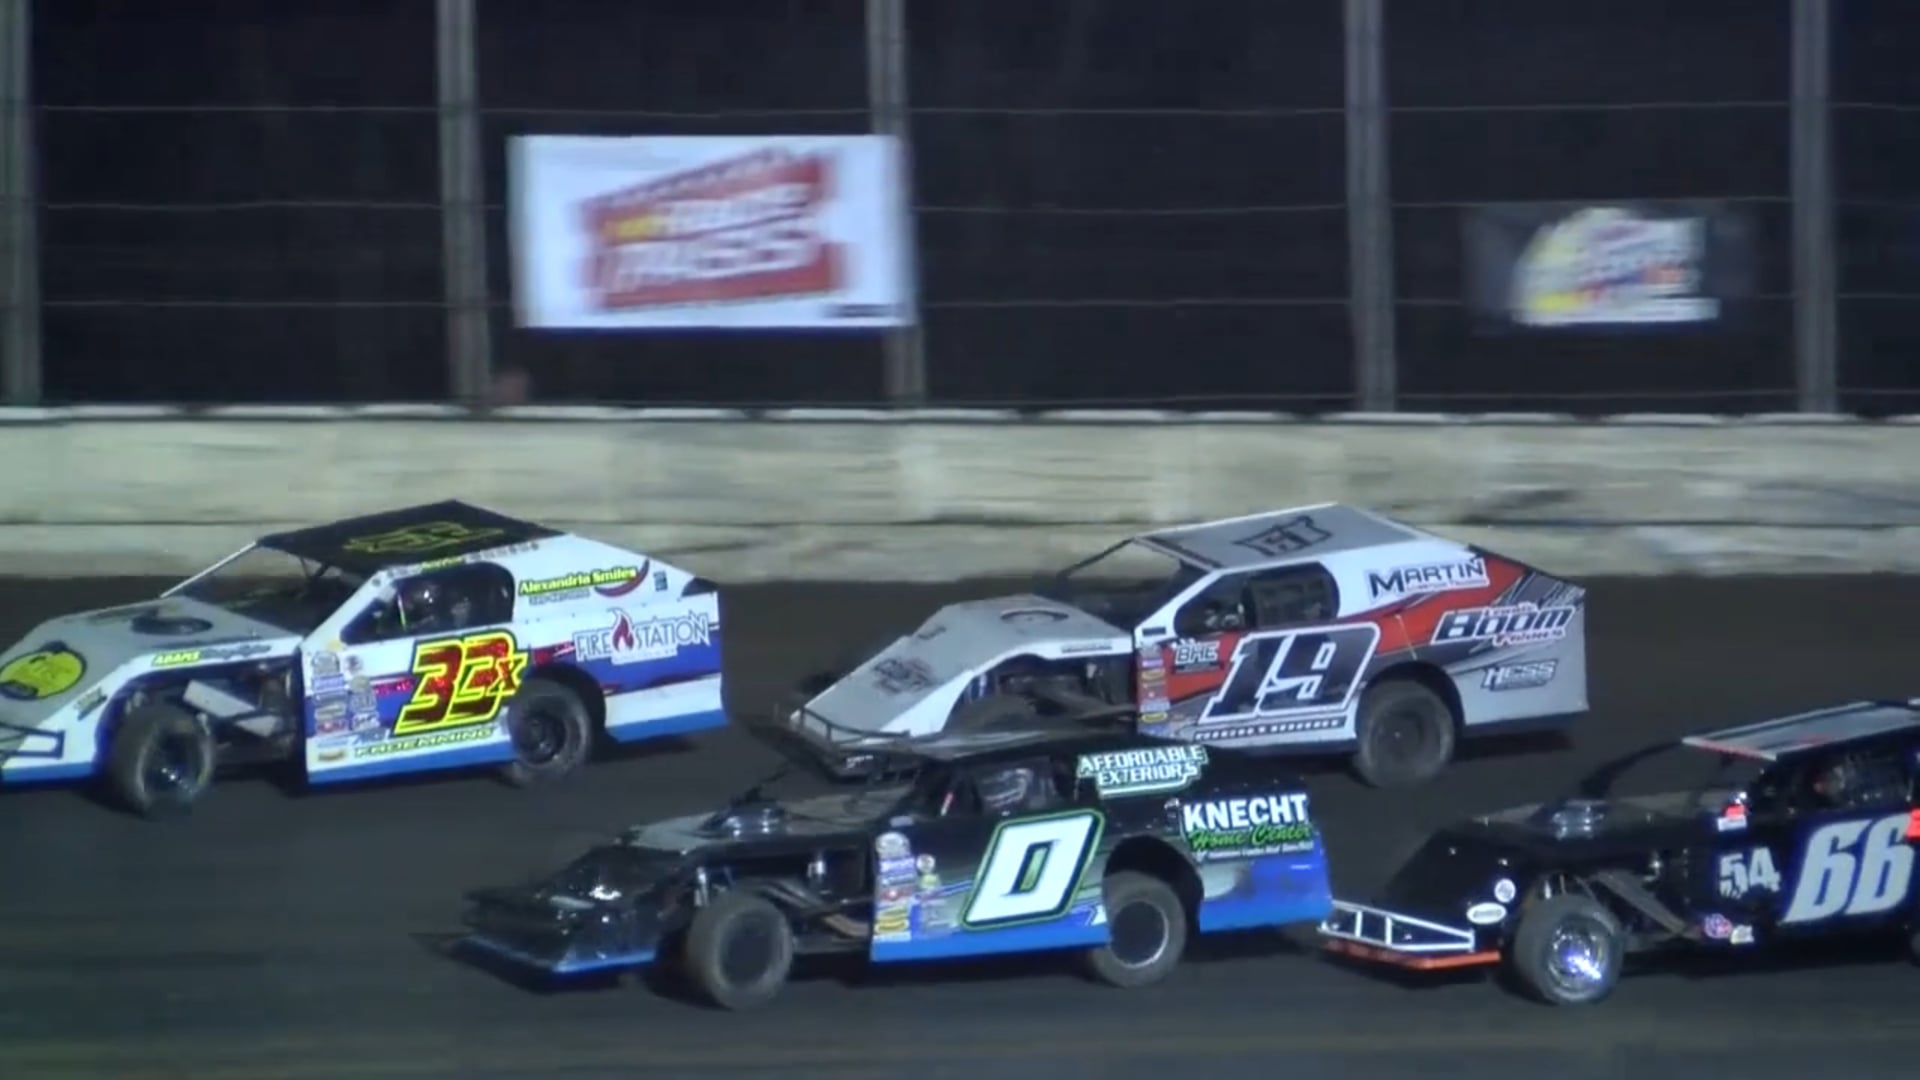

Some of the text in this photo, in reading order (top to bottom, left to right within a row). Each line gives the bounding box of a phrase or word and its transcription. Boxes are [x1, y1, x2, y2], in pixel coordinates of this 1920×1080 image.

[520, 573, 591, 596] Alexandria
[592, 567, 636, 585] Smiles
[576, 631, 612, 657] FIRE
[635, 611, 710, 648] STATION
[1200, 621, 1380, 723] 19
[1079, 745, 1204, 773] AFFORDABLE
[1183, 793, 1307, 831] KNECHT
[1720, 847, 1781, 899] 54
[1782, 813, 1915, 922] 66
